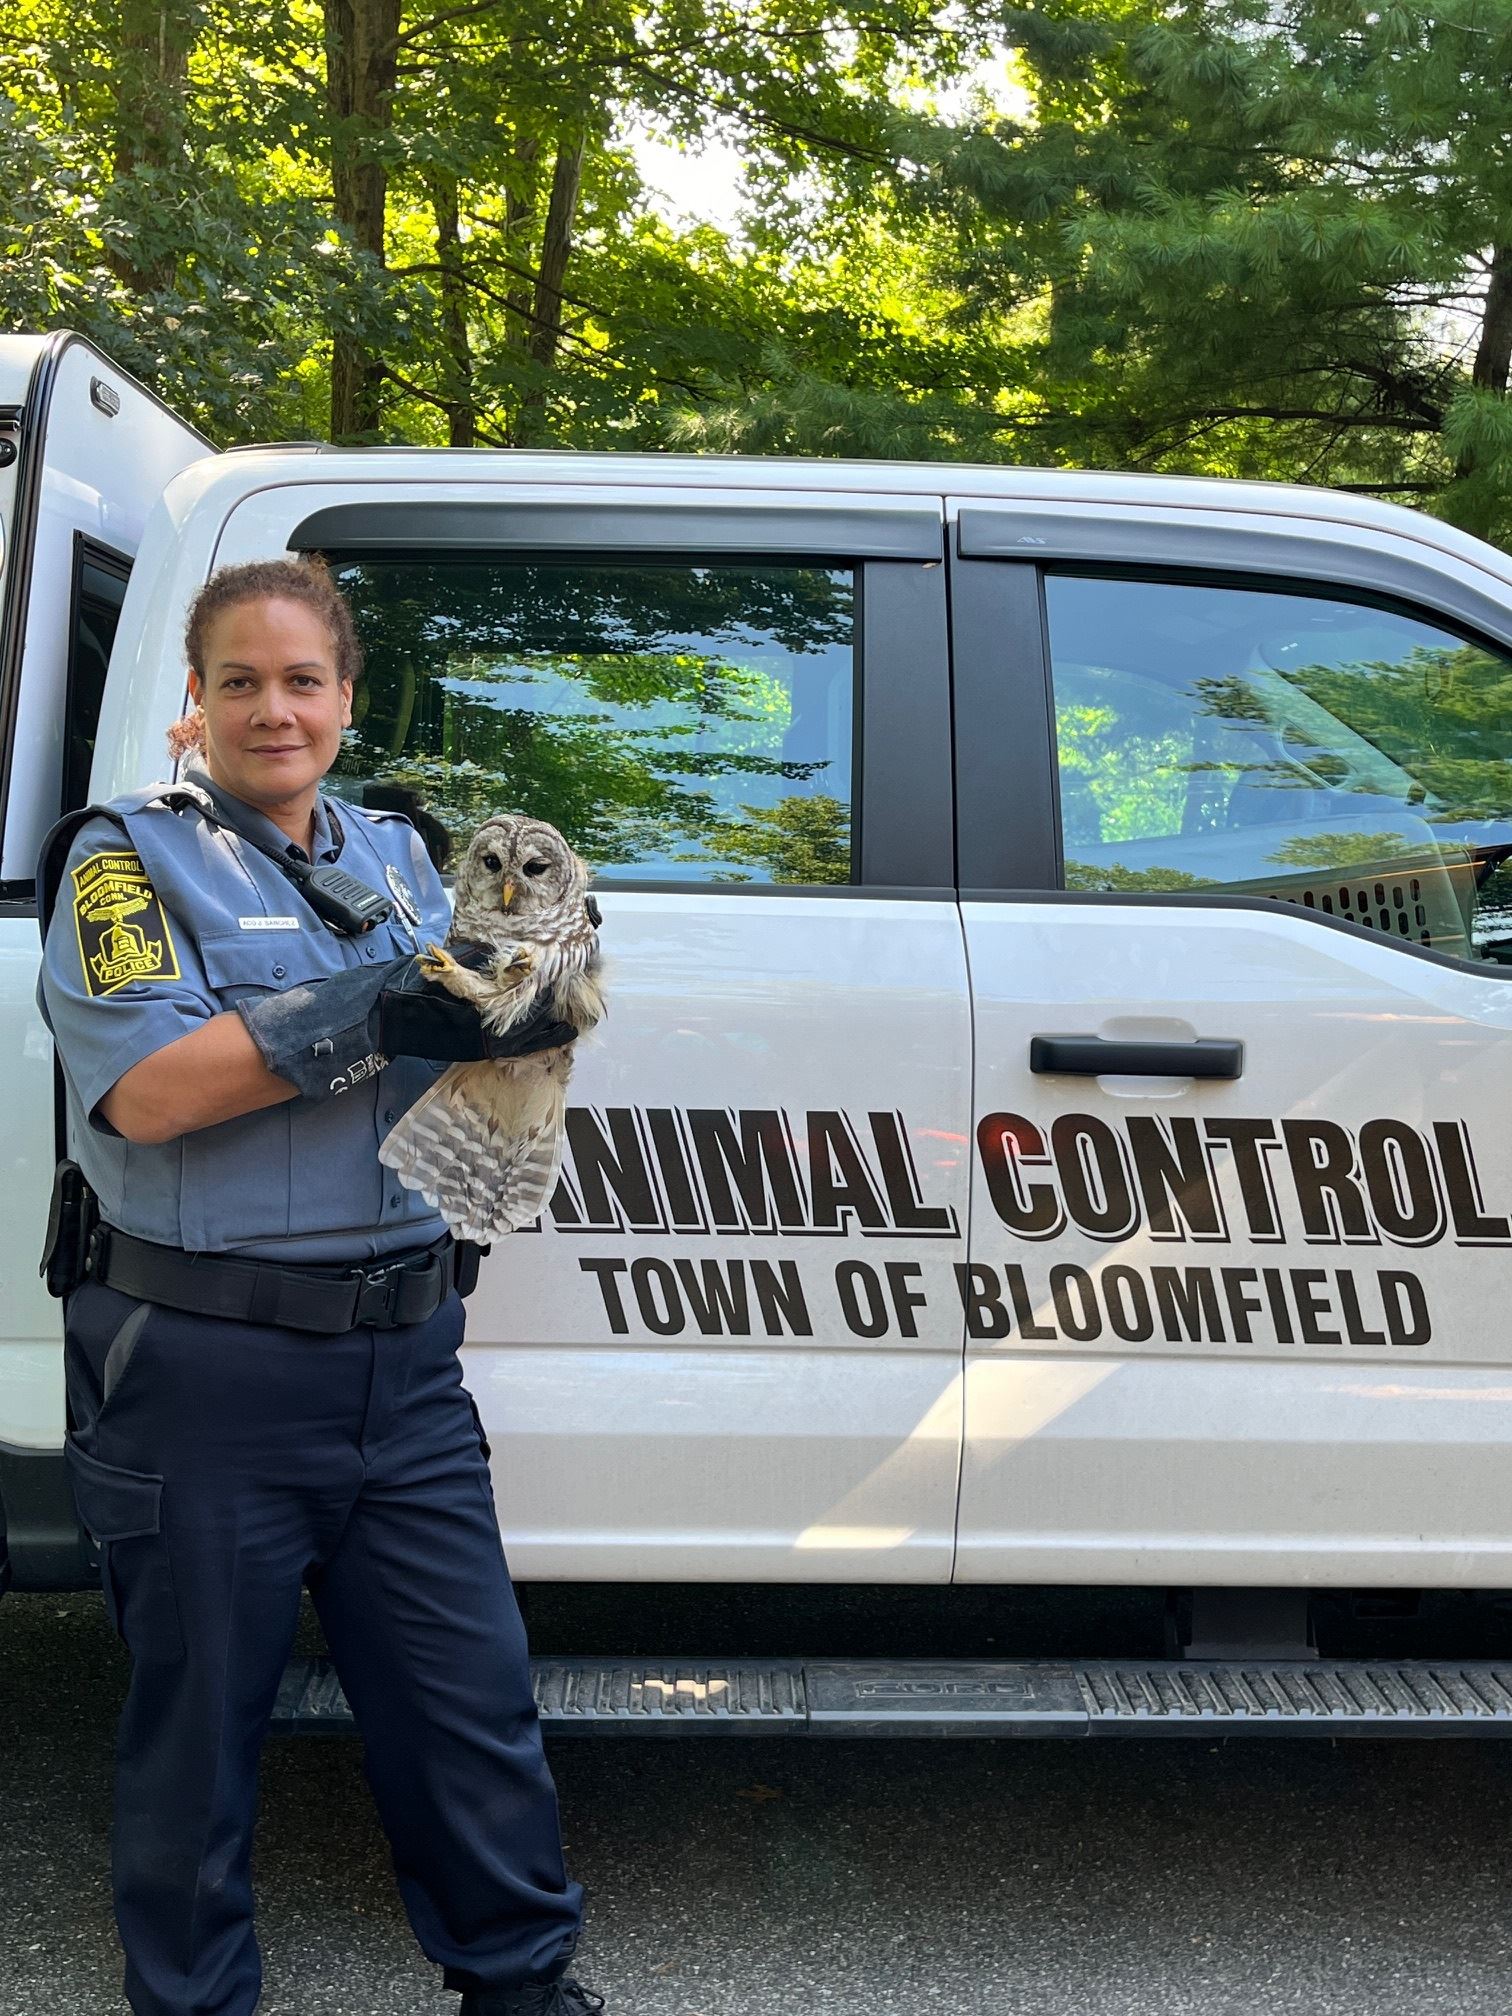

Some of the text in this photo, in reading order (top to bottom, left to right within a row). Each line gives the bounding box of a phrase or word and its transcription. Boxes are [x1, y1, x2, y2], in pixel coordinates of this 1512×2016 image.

[80, 859, 143, 887] ANIMAL CONTROL
[79, 880, 153, 917] BLOOMFIELD
[100, 893, 127, 906] CONN.
[105, 959, 155, 980] POLICE
[977, 1111, 1512, 1249] CONTROL
[578, 1256, 1432, 1346] TOWN OF BLOOMFIELD
